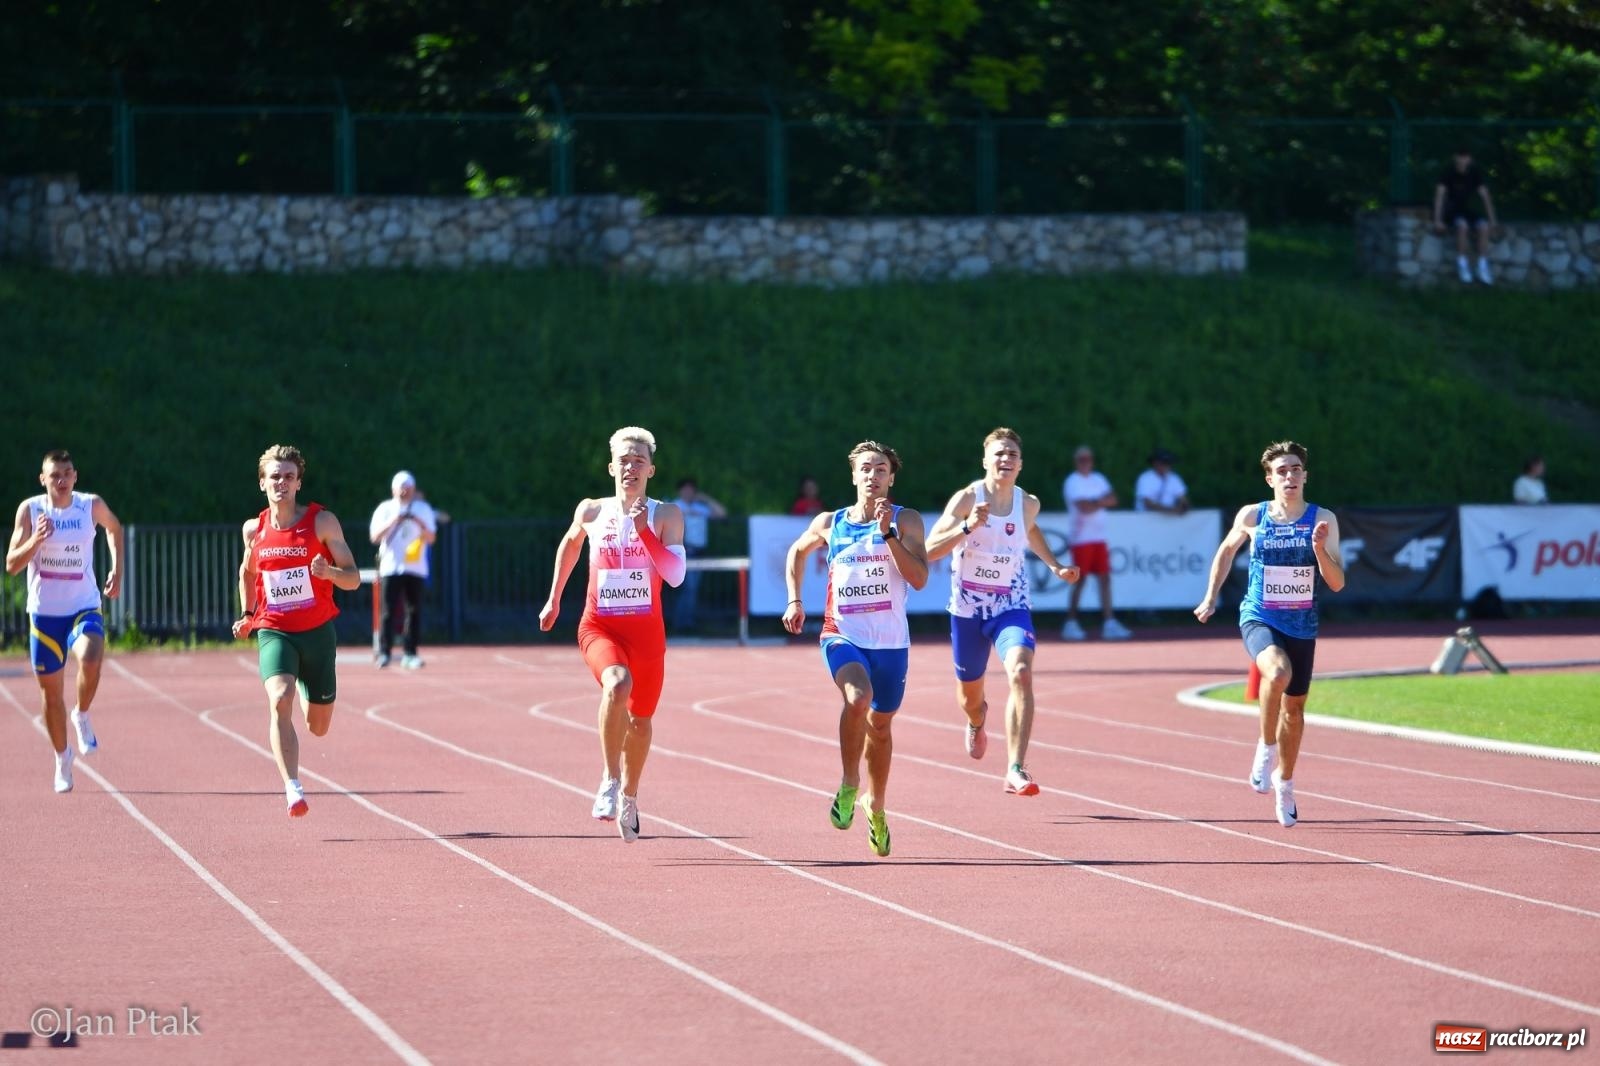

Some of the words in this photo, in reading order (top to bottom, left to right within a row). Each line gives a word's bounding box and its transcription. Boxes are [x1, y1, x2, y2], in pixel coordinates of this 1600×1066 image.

[64, 544, 80, 553] 445
[1263, 537, 1307, 549] CROATIA
[599, 547, 646, 557] POLSKA
[1393, 536, 1446, 572] 4F
[1532, 530, 1600, 577] pol
[41, 557, 83, 568] MYKHAYLENKO
[856, 554, 890, 563] REPUBLIC
[992, 555, 1011, 565] 349
[286, 569, 304, 580] 245
[629, 571, 643, 581] 45
[865, 567, 885, 578] 145
[975, 566, 1001, 579] ŽIGO
[1293, 569, 1311, 578] 545
[270, 584, 303, 598] SÁRAY
[599, 587, 649, 599] ADAMCZYK
[838, 583, 889, 598] KORECEK
[1265, 583, 1311, 594] DELONGA
